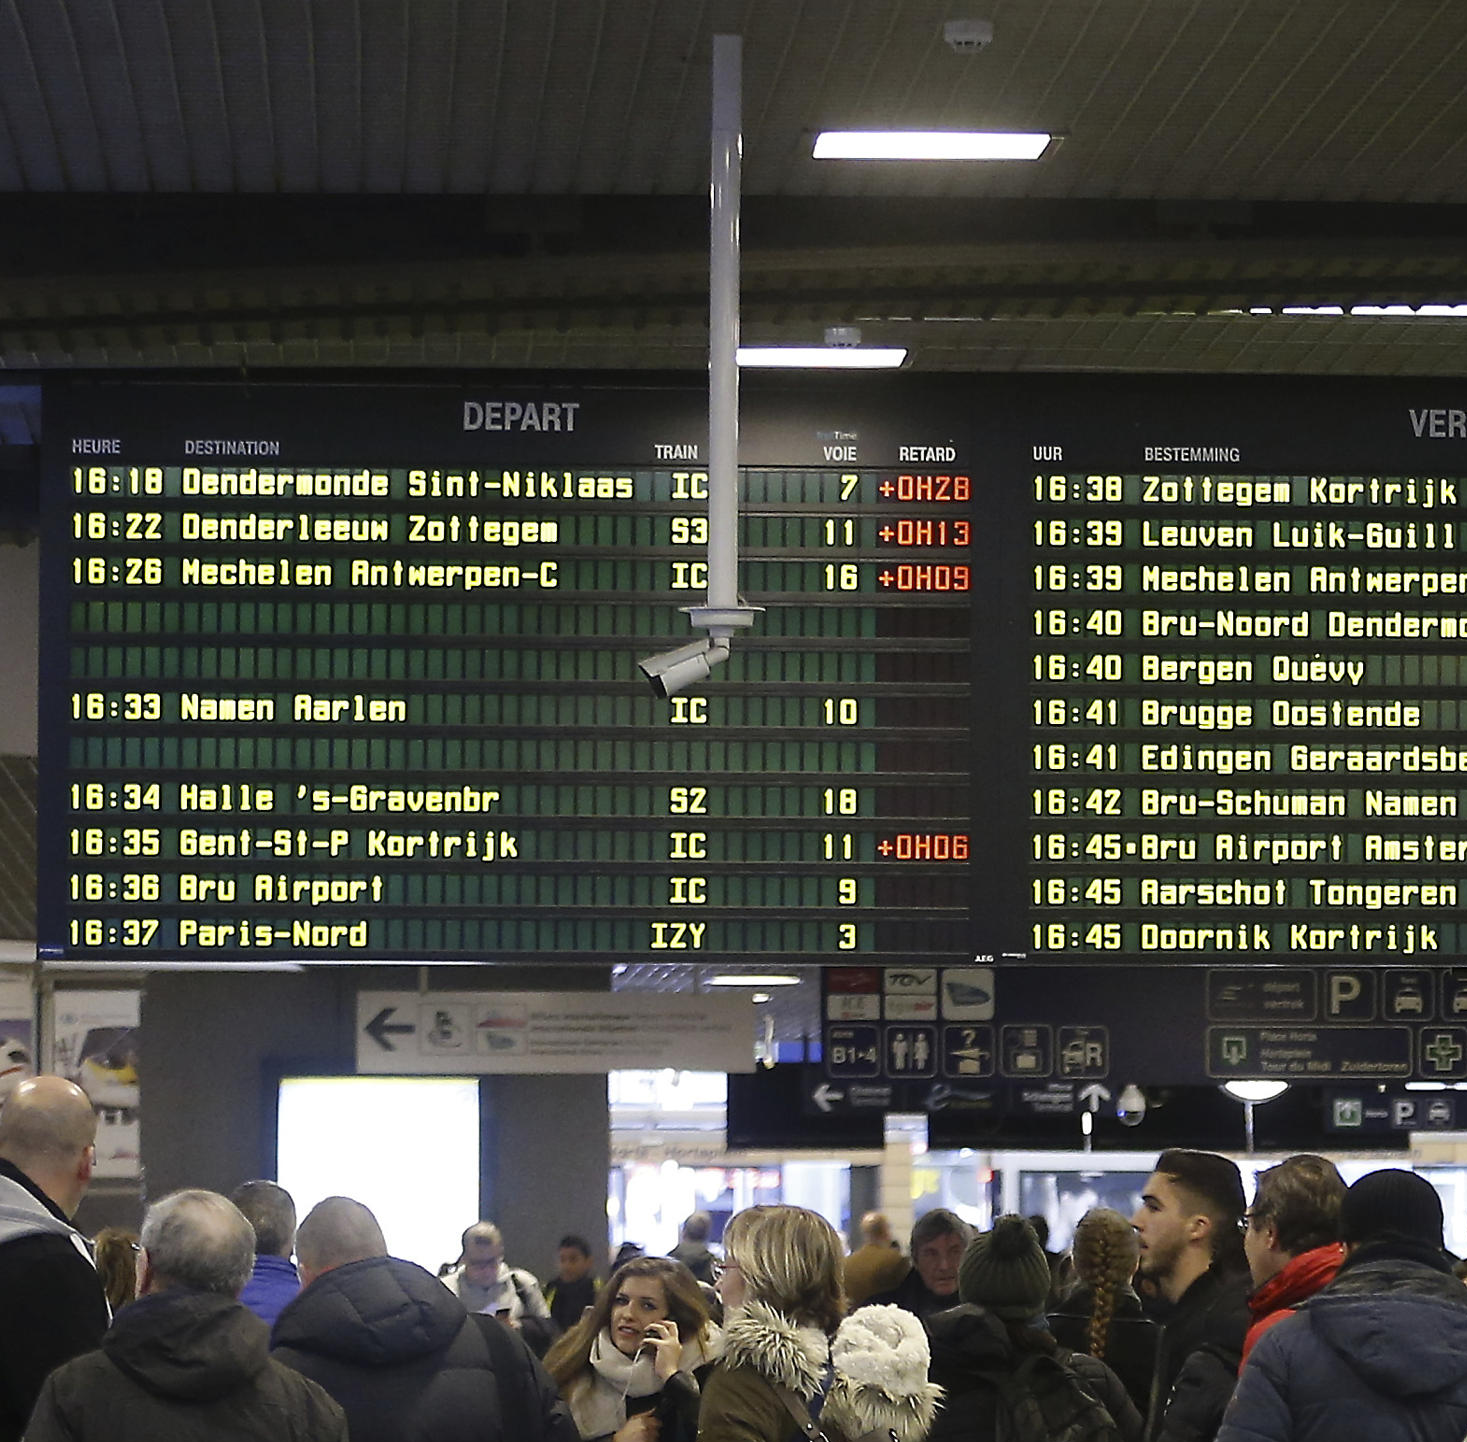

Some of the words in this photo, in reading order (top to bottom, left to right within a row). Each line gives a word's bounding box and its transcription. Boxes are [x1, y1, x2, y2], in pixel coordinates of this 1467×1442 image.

[463, 401, 580, 432] DEPART
[72, 439, 121, 454] HEURE
[185, 440, 280, 456] DESTINATION
[654, 444, 698, 460] TRAIN
[823, 446, 857, 461] VOIE
[899, 446, 956, 462] RETARD
[1033, 446, 1063, 461] UUR
[1144, 447, 1240, 463] BESTEMMING
[74, 467, 163, 494] 16:18
[183, 467, 389, 496] Dendermonde
[409, 470, 633, 498] Sint-Niklaas
[672, 472, 708, 499] IC
[841, 474, 858, 501] 7
[1034, 475, 1122, 501] 16:38
[1143, 476, 1290, 507] Zottegem
[1310, 477, 1457, 508] Kortrijk
[73, 557, 162, 585] 16:26
[182, 558, 332, 586] Mechelen
[351, 559, 558, 591] Antwerpen-C
[671, 562, 708, 589] IC
[825, 564, 858, 590] 16
[1033, 654, 1122, 680] 16:40
[1142, 655, 1252, 685] Bergen
[1273, 653, 1364, 686] Quévy
[71, 783, 160, 810] 16:34
[180, 784, 273, 811] Halle
[297, 784, 500, 812] 's-Gravenbr
[670, 787, 707, 814] S2
[824, 788, 857, 815] 18
[1033, 788, 1121, 815] 16:42
[1142, 789, 1345, 816] Bru-Schuman
[1365, 790, 1457, 816] Namen
[70, 828, 160, 856] 16:35
[180, 829, 349, 857] Gent-St-P
[368, 830, 518, 861] Kortrijk
[670, 832, 706, 859] IC
[824, 833, 851, 860] 11
[1033, 833, 1122, 860] 16:45
[1141, 833, 1196, 860] Bru
[1216, 834, 1342, 864] Airport
